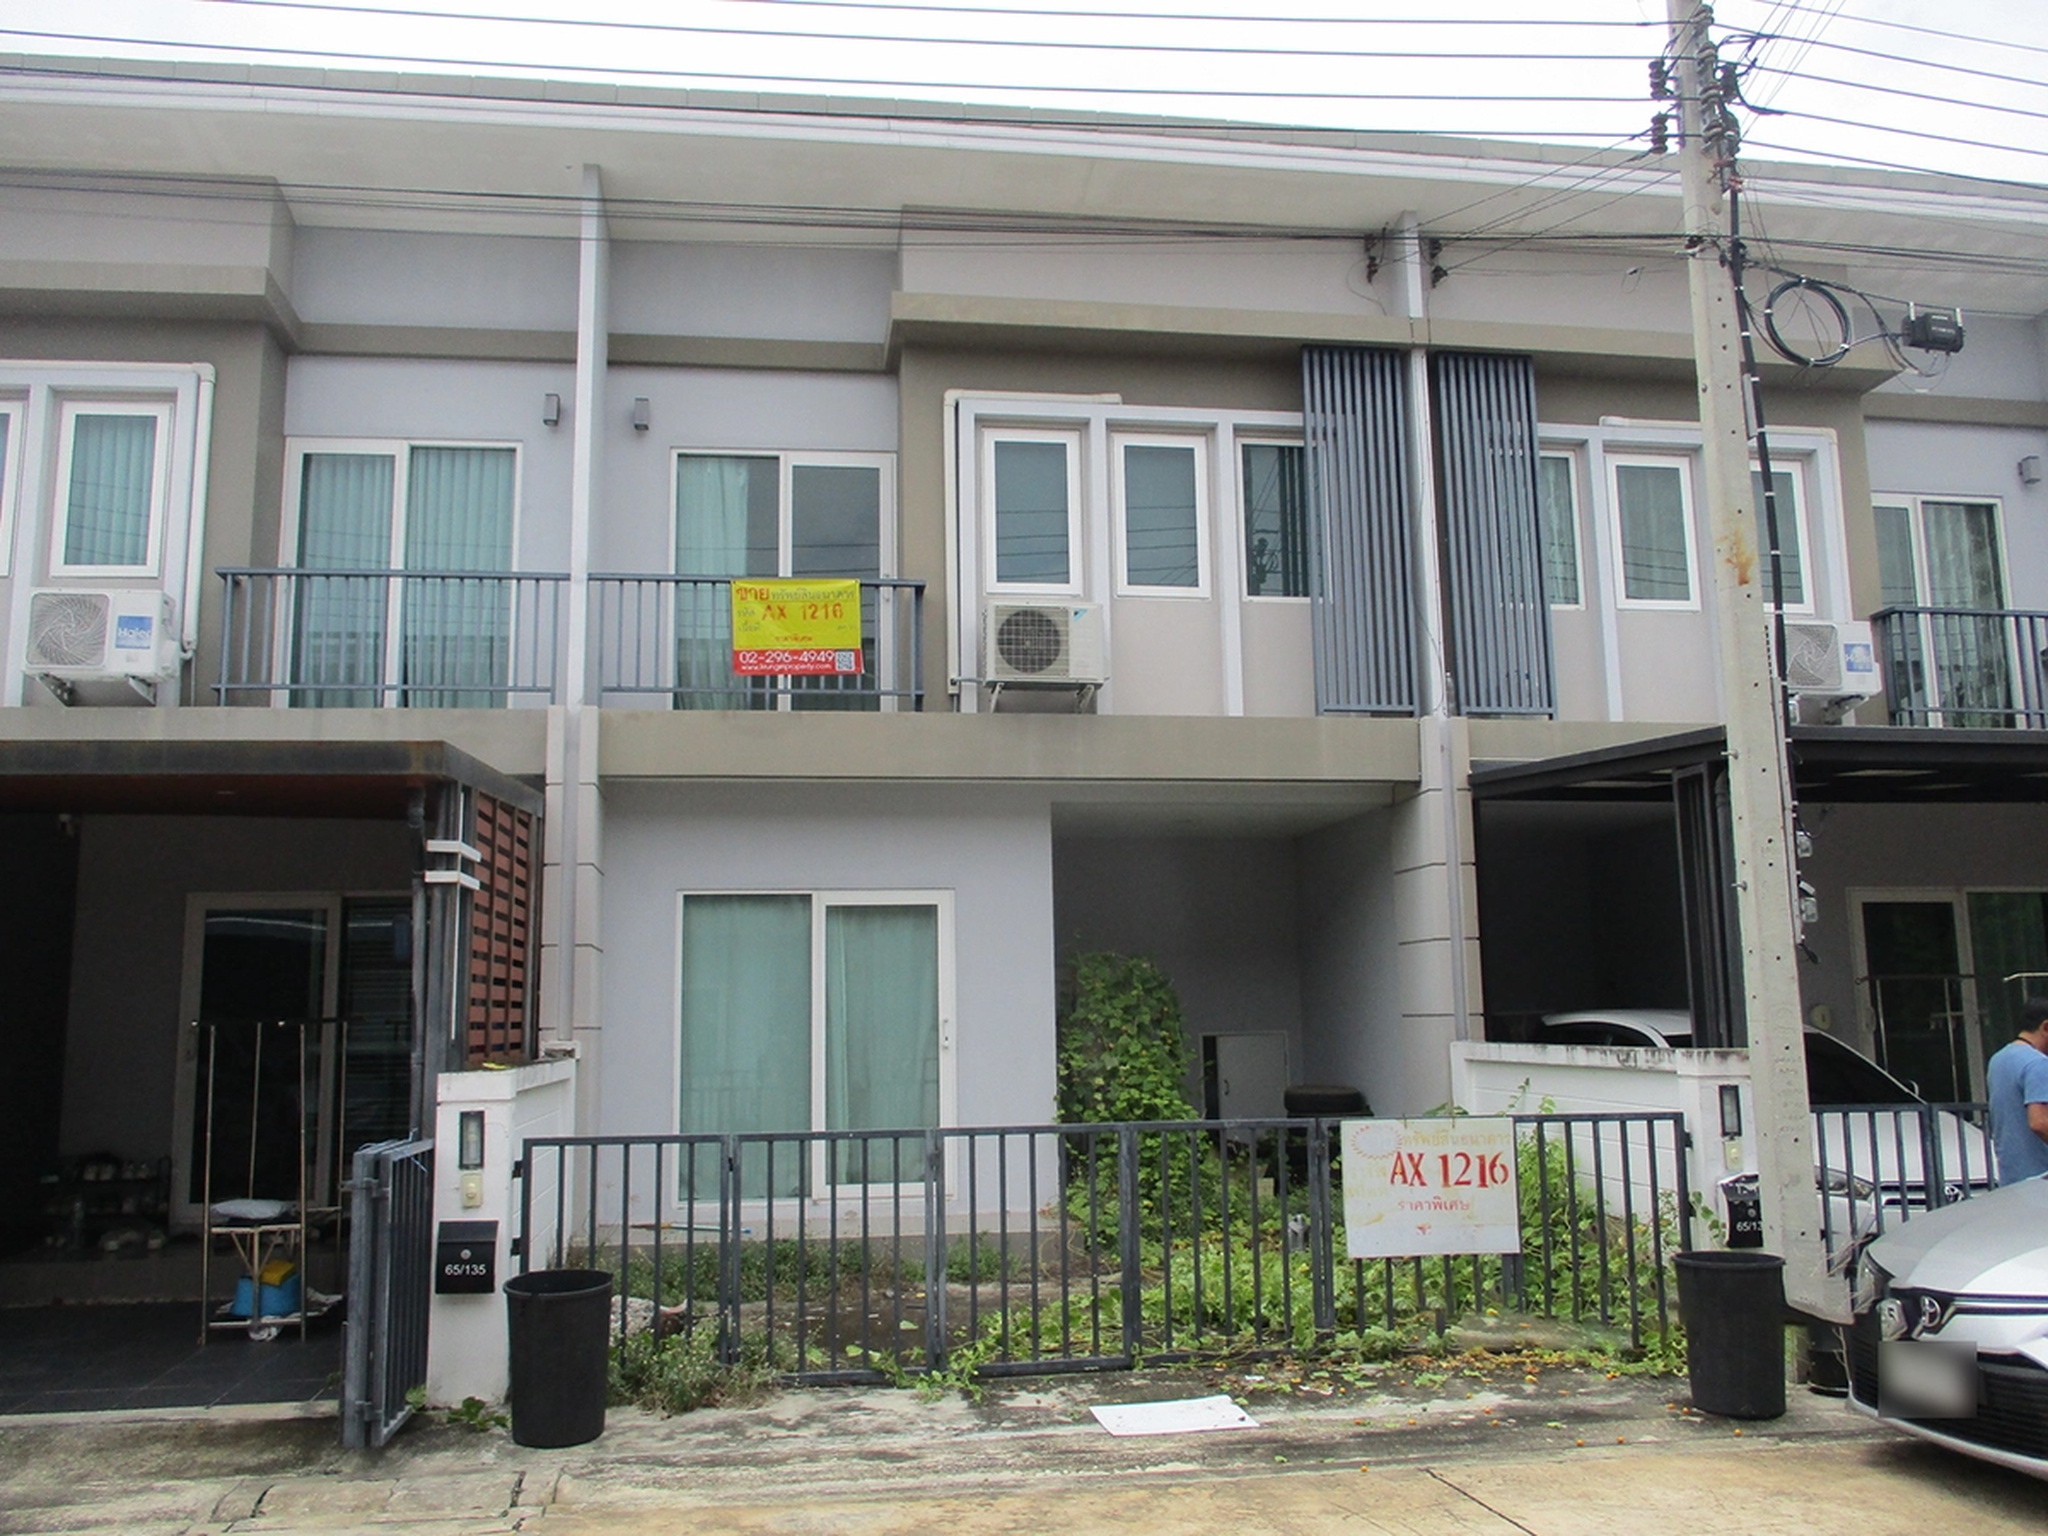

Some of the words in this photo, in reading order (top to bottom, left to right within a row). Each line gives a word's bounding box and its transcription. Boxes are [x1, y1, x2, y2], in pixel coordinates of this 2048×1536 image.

[736, 587, 770, 601] ขาย
[761, 604, 787, 621] AX
[801, 602, 844, 620] 1216
[118, 628, 151, 638] Haier
[739, 651, 835, 664] 02-296-4949
[1390, 1150, 1428, 1187] AX
[1438, 1151, 1510, 1188] 1216
[1398, 1195, 1471, 1212] ราคาพิเศษ
[444, 1263, 487, 1276] 65/135
